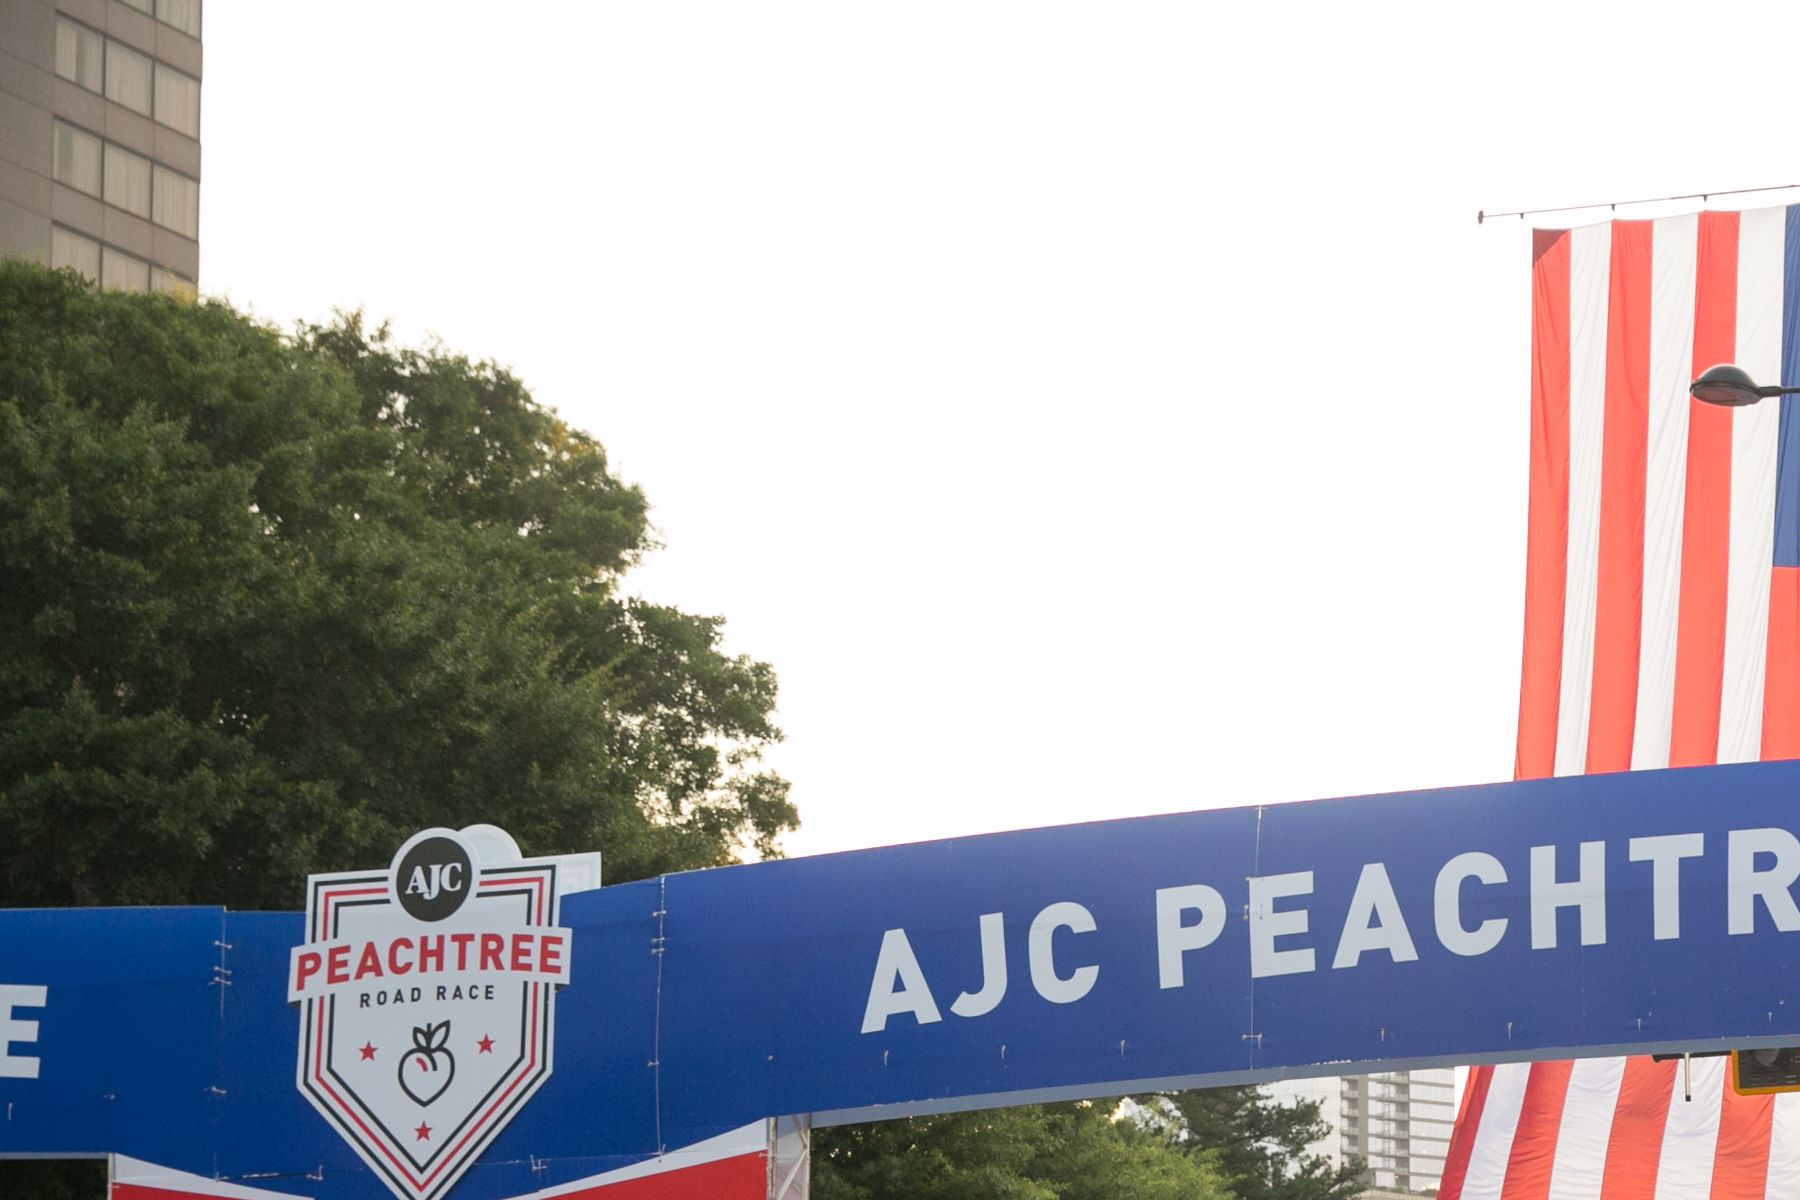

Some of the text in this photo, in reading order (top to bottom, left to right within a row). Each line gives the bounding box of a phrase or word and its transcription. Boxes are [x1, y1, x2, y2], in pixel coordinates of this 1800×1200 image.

[405, 862, 462, 900] AJC
[296, 933, 563, 992] PEACHTREE
[860, 902, 1100, 1034] AJC
[360, 984, 495, 1008] ROAD RACE
